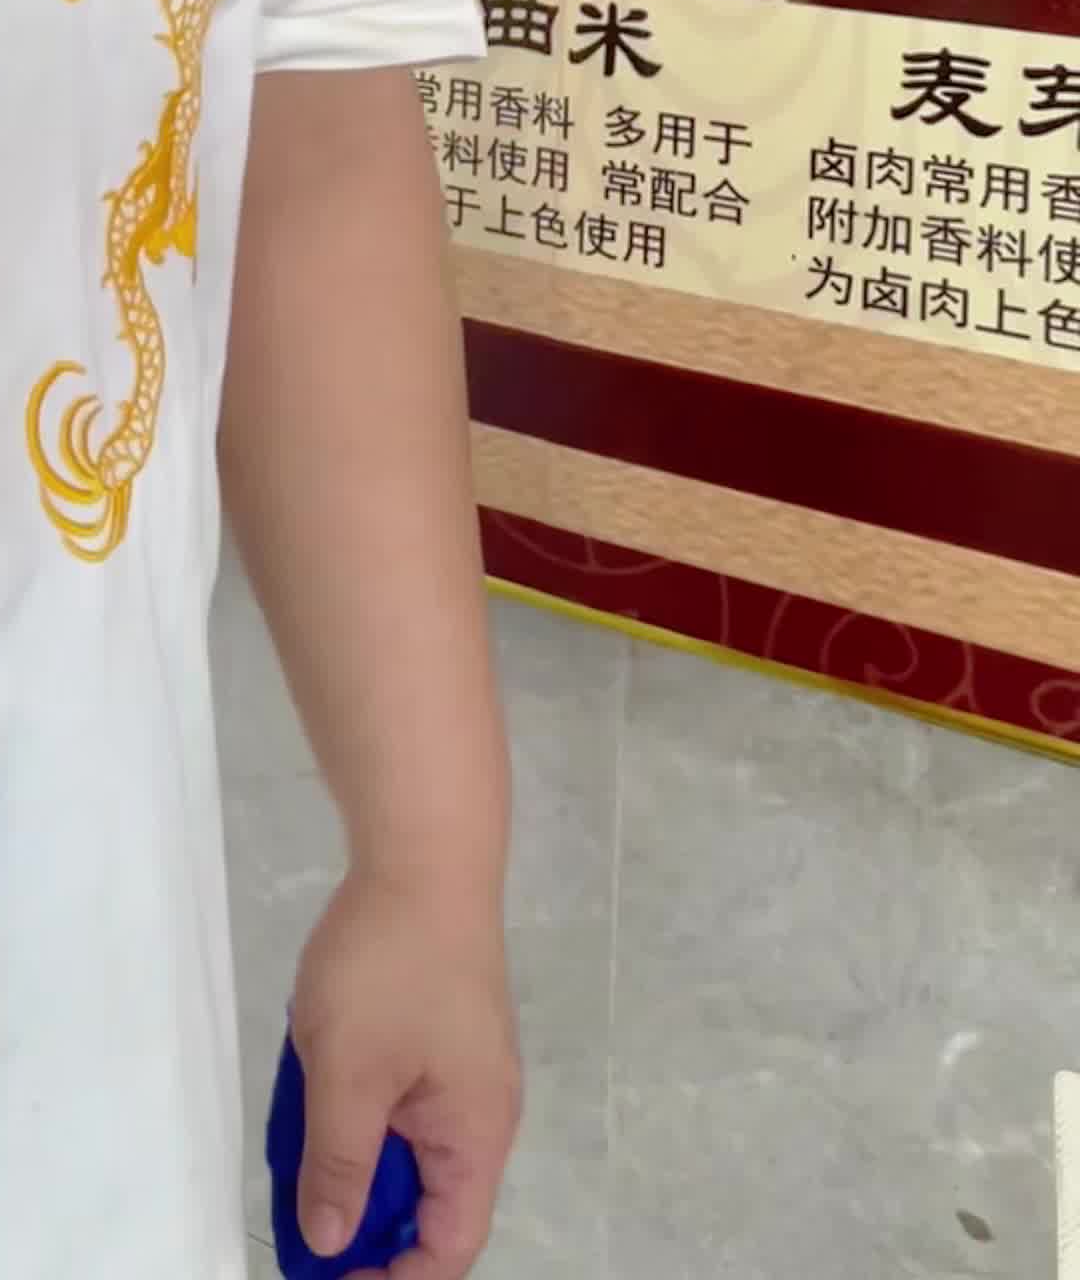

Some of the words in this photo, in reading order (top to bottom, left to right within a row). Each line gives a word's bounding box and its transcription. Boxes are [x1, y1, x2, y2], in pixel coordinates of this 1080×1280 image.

[415, 70, 575, 141] 常用香料
[604, 104, 754, 167] 多用于
[601, 159, 751, 227] 常配合
[809, 136, 1080, 222] 卤肉常用香
[445, 184, 666, 269] 于上色使用
[805, 255, 1080, 352] 为卤肉上色
